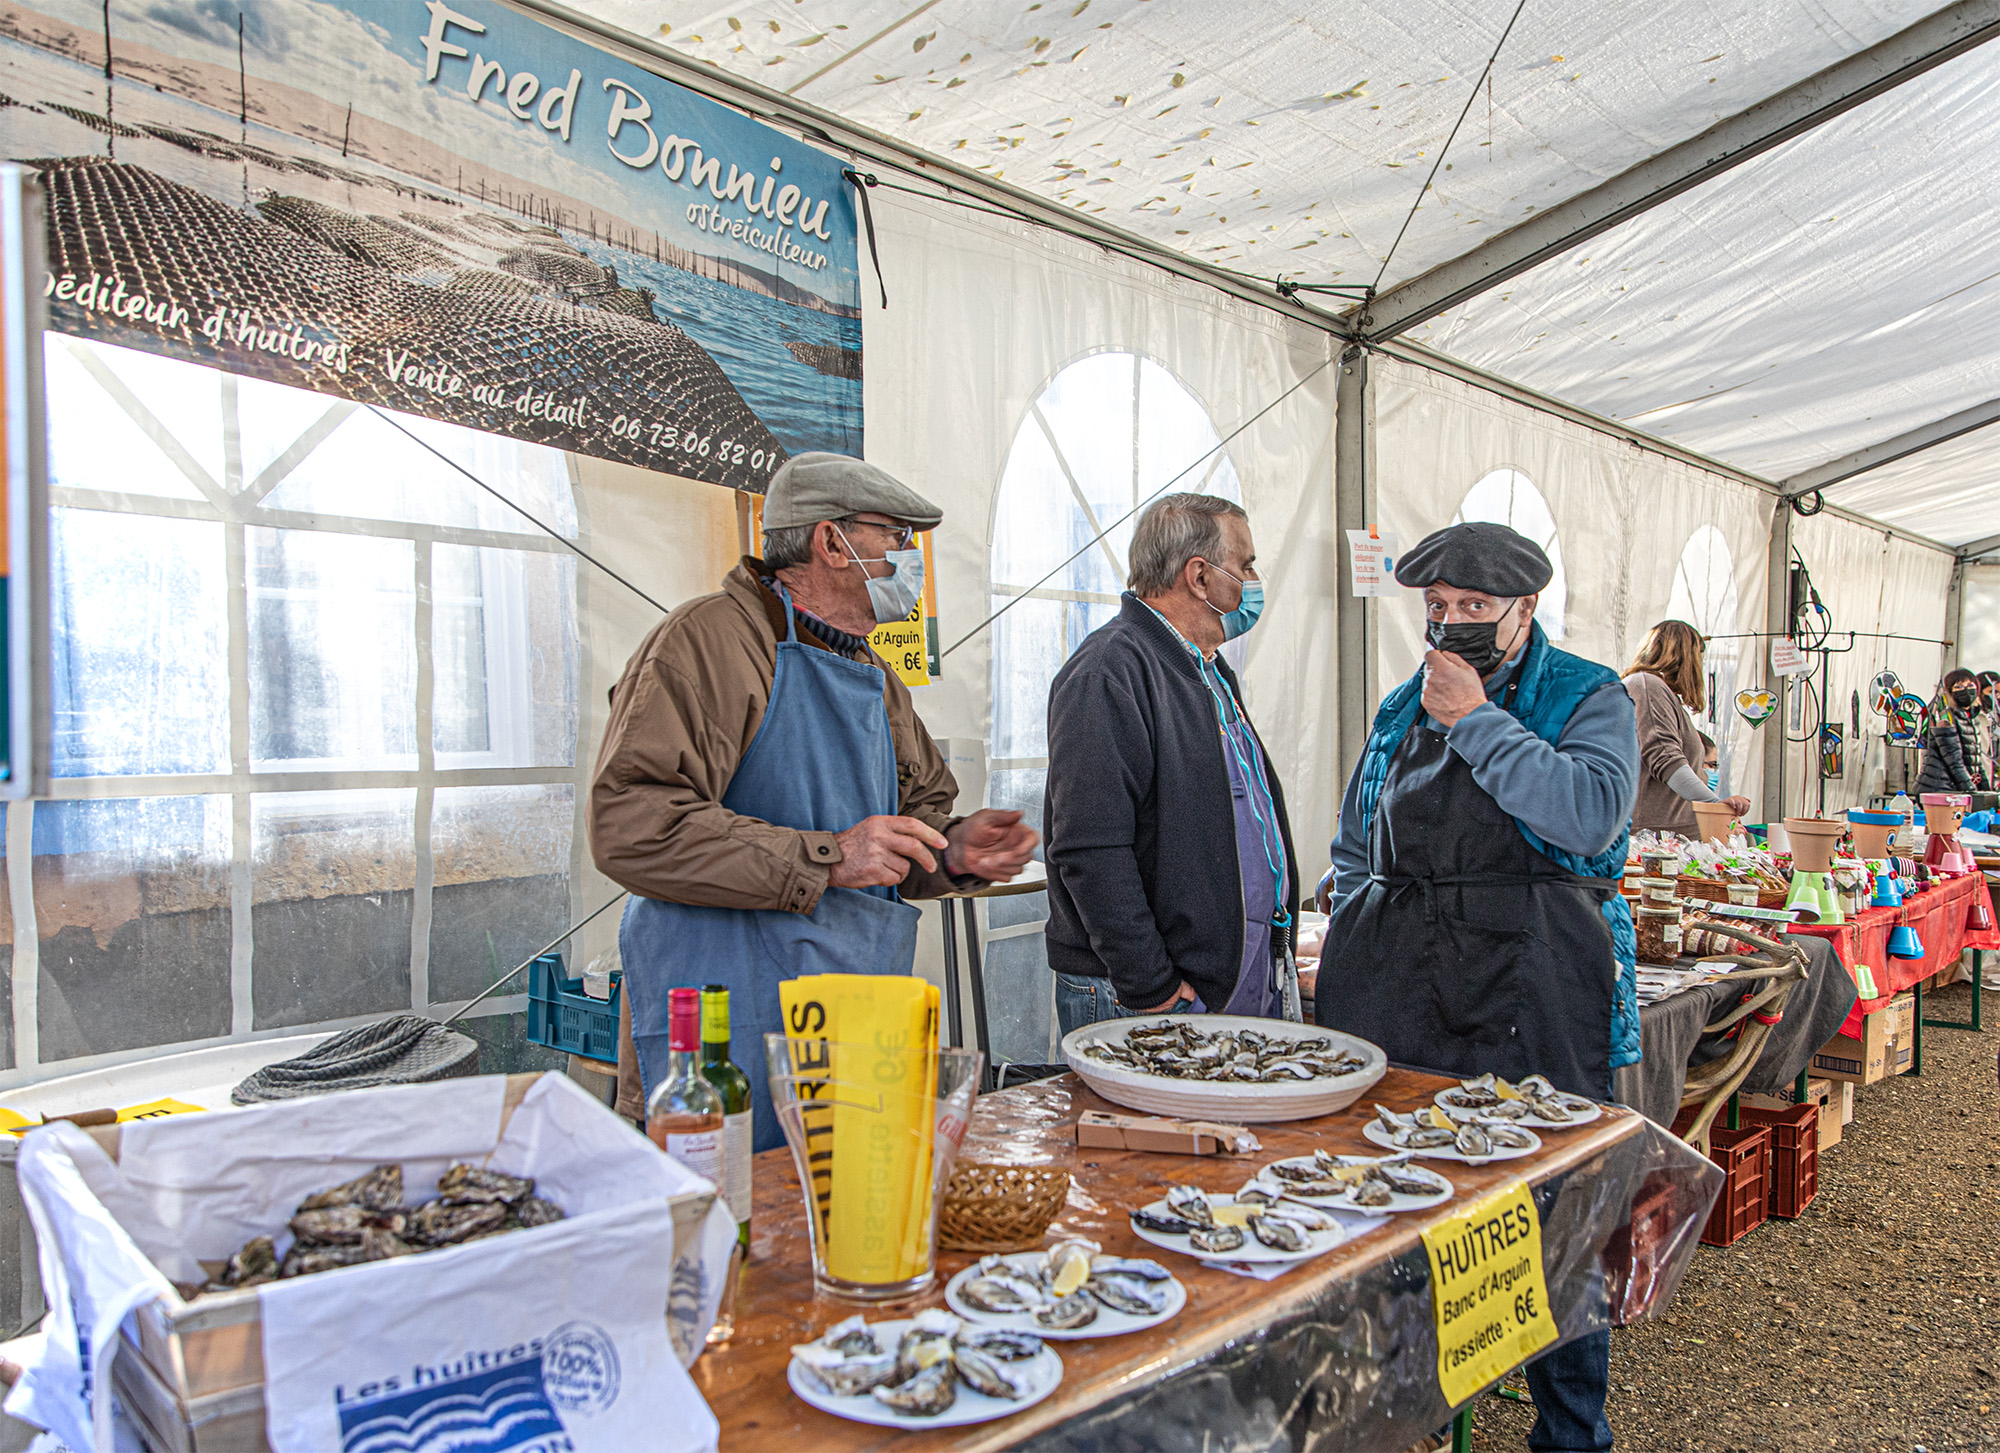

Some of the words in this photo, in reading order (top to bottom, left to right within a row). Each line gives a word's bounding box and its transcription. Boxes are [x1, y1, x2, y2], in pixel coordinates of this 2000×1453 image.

[419, 0, 583, 142] Fred
[603, 78, 831, 241] Bonnieu
[686, 202, 828, 271] ostréiculteur
[385, 348, 463, 397] Vente
[472, 384, 506, 410] au
[515, 386, 588, 429] détail
[611, 414, 642, 440] 06
[650, 423, 679, 448] 73
[684, 431, 711, 458] 06
[717, 440, 745, 466] 82
[750, 449, 777, 473] 01
[873, 631, 920, 648] d'Arguin
[904, 652, 921, 670] 6€
[1436, 1203, 1531, 1285] HUÎTRES
[1443, 1294, 1476, 1325] Banc
[1478, 1257, 1531, 1299] d'Arguin
[1444, 1323, 1504, 1373] l'assiette
[1515, 1287, 1538, 1325] 6€
[335, 1375, 400, 1405] Les
